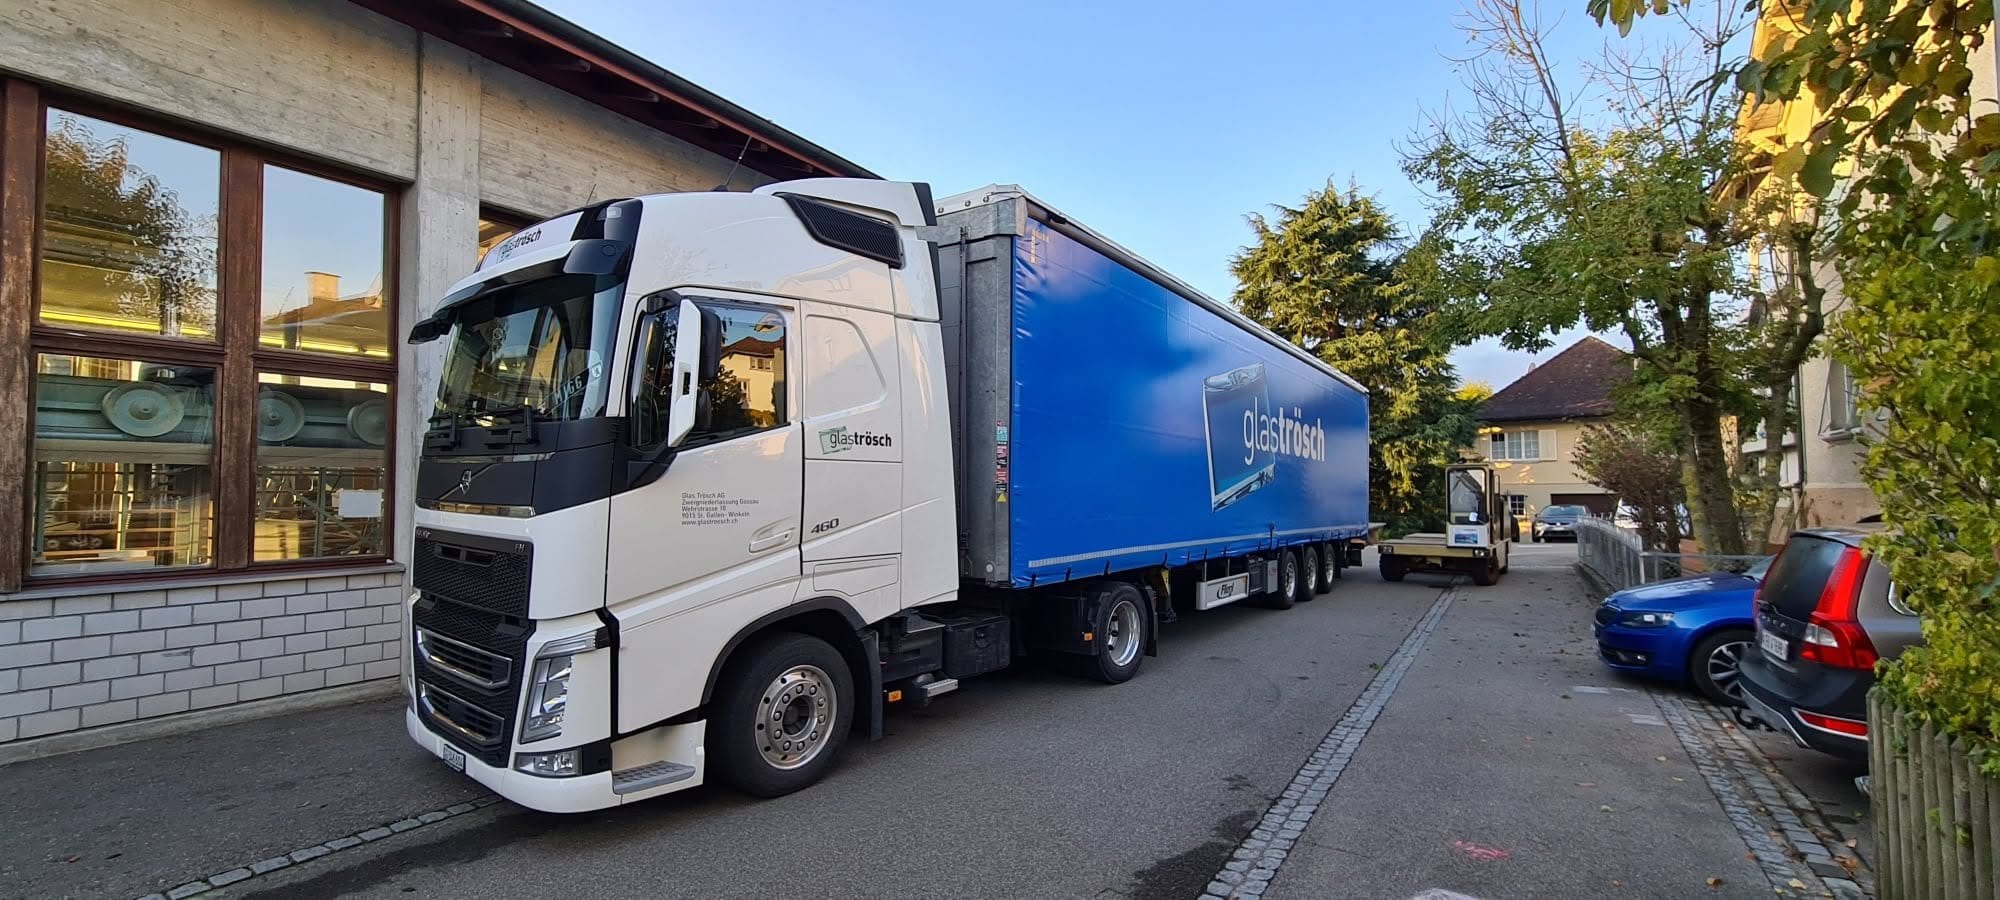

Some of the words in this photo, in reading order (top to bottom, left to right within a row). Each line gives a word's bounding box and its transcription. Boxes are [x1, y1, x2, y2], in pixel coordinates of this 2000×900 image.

[829, 430, 892, 449] glaströsch
[1243, 396, 1325, 466] glaströsch
[811, 518, 839, 533] 460
